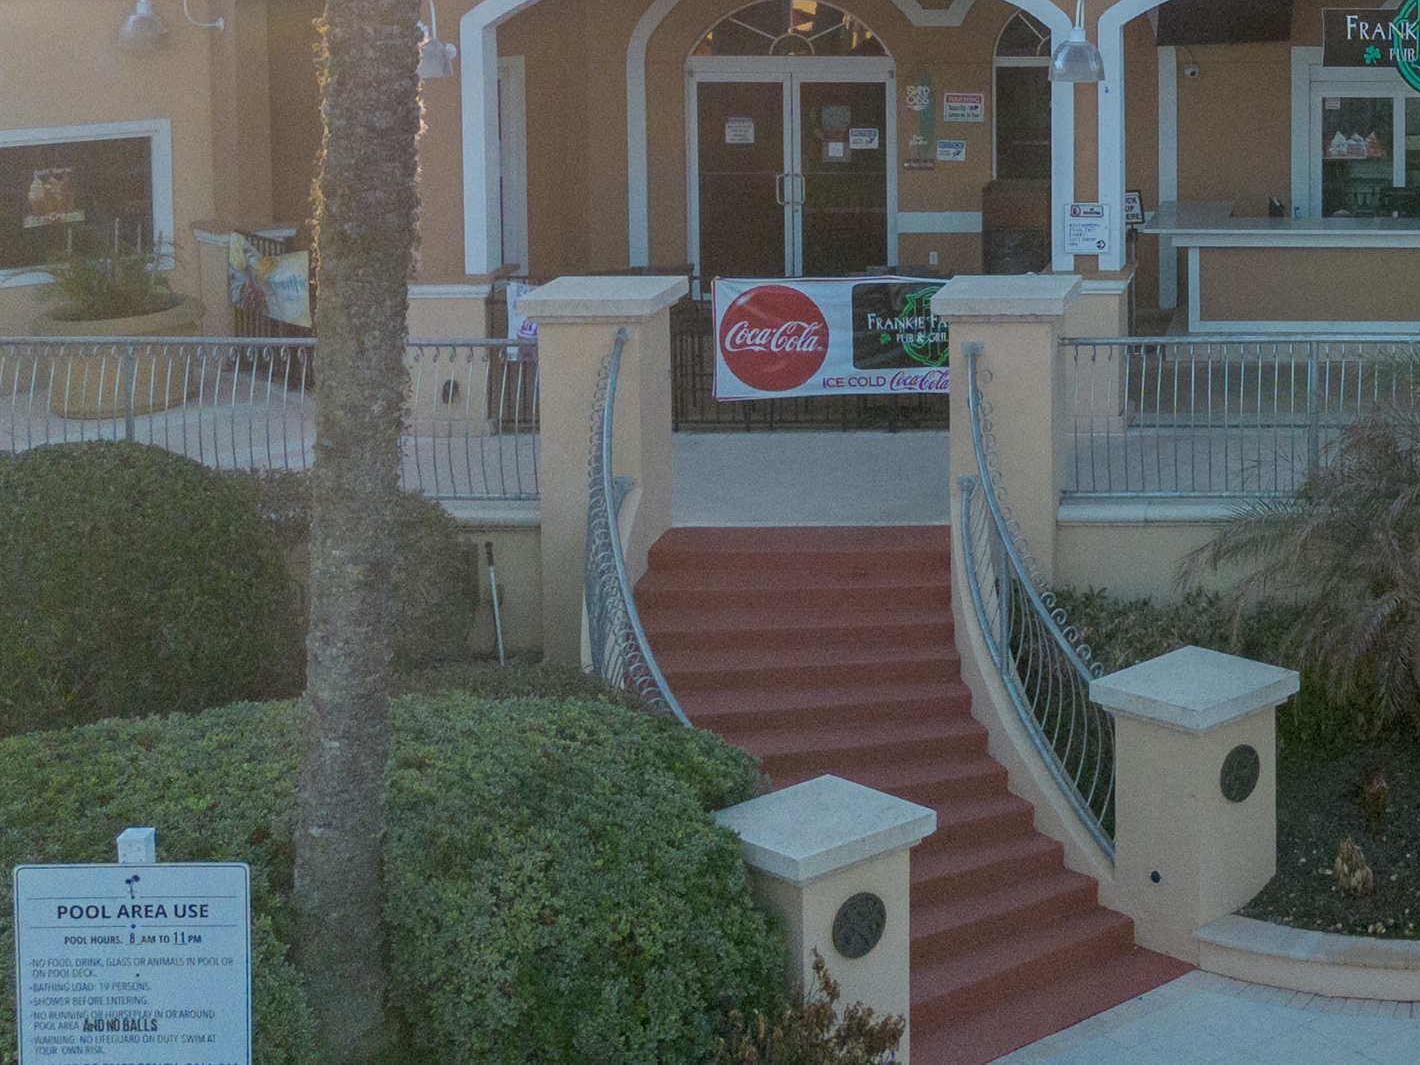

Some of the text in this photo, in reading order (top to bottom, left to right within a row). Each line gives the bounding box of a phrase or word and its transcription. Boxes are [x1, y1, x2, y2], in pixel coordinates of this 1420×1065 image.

[1389, 47, 1415, 63] PUB
[867, 313, 925, 330] FRANKIE
[725, 321, 822, 353] Coca-Cola
[896, 331, 949, 343] PUB & GRIL
[822, 377, 844, 389] ICE
[847, 376, 886, 387] COLD
[57, 903, 209, 920] POOL AREA USE
[64, 935, 87, 945] POOL
[141, 935, 156, 944] AM
[159, 935, 170, 944] TO
[173, 931, 186, 944] 11
[187, 935, 202, 944] PM
[106, 957, 132, 967] GLASS
[133, 957, 146, 967] OR
[147, 957, 185, 967] ANIMALS
[186, 957, 195, 966] IN
[197, 957, 219, 966] POOL
[221, 957, 234, 966] OR
[32, 968, 46, 978] ON
[47, 968, 70, 978] POOL
[72, 996, 103, 1006] BEFORE
[49, 1010, 87, 1020] RUNNING
[91, 1010, 103, 1019] OR
[105, 1009, 153, 1019] HORSEPLAY
[154, 1009, 163, 1019] IN
[165, 1009, 178, 1019] OR
[179, 1009, 216, 1019] AROUND
[33, 1021, 56, 1031] POOL
[106, 1018, 120, 1032] NO
[123, 1018, 158, 1032] BALLS
[80, 1035, 93, 1044] NO
[95, 1034, 140, 1044] LIFEGUARD
[142, 1034, 155, 1044] ON
[181, 1034, 206, 1043] SWIM
[207, 1034, 216, 1043] AT
[34, 1045, 58, 1055] YOUR
[61, 1045, 83, 1055] OWN
